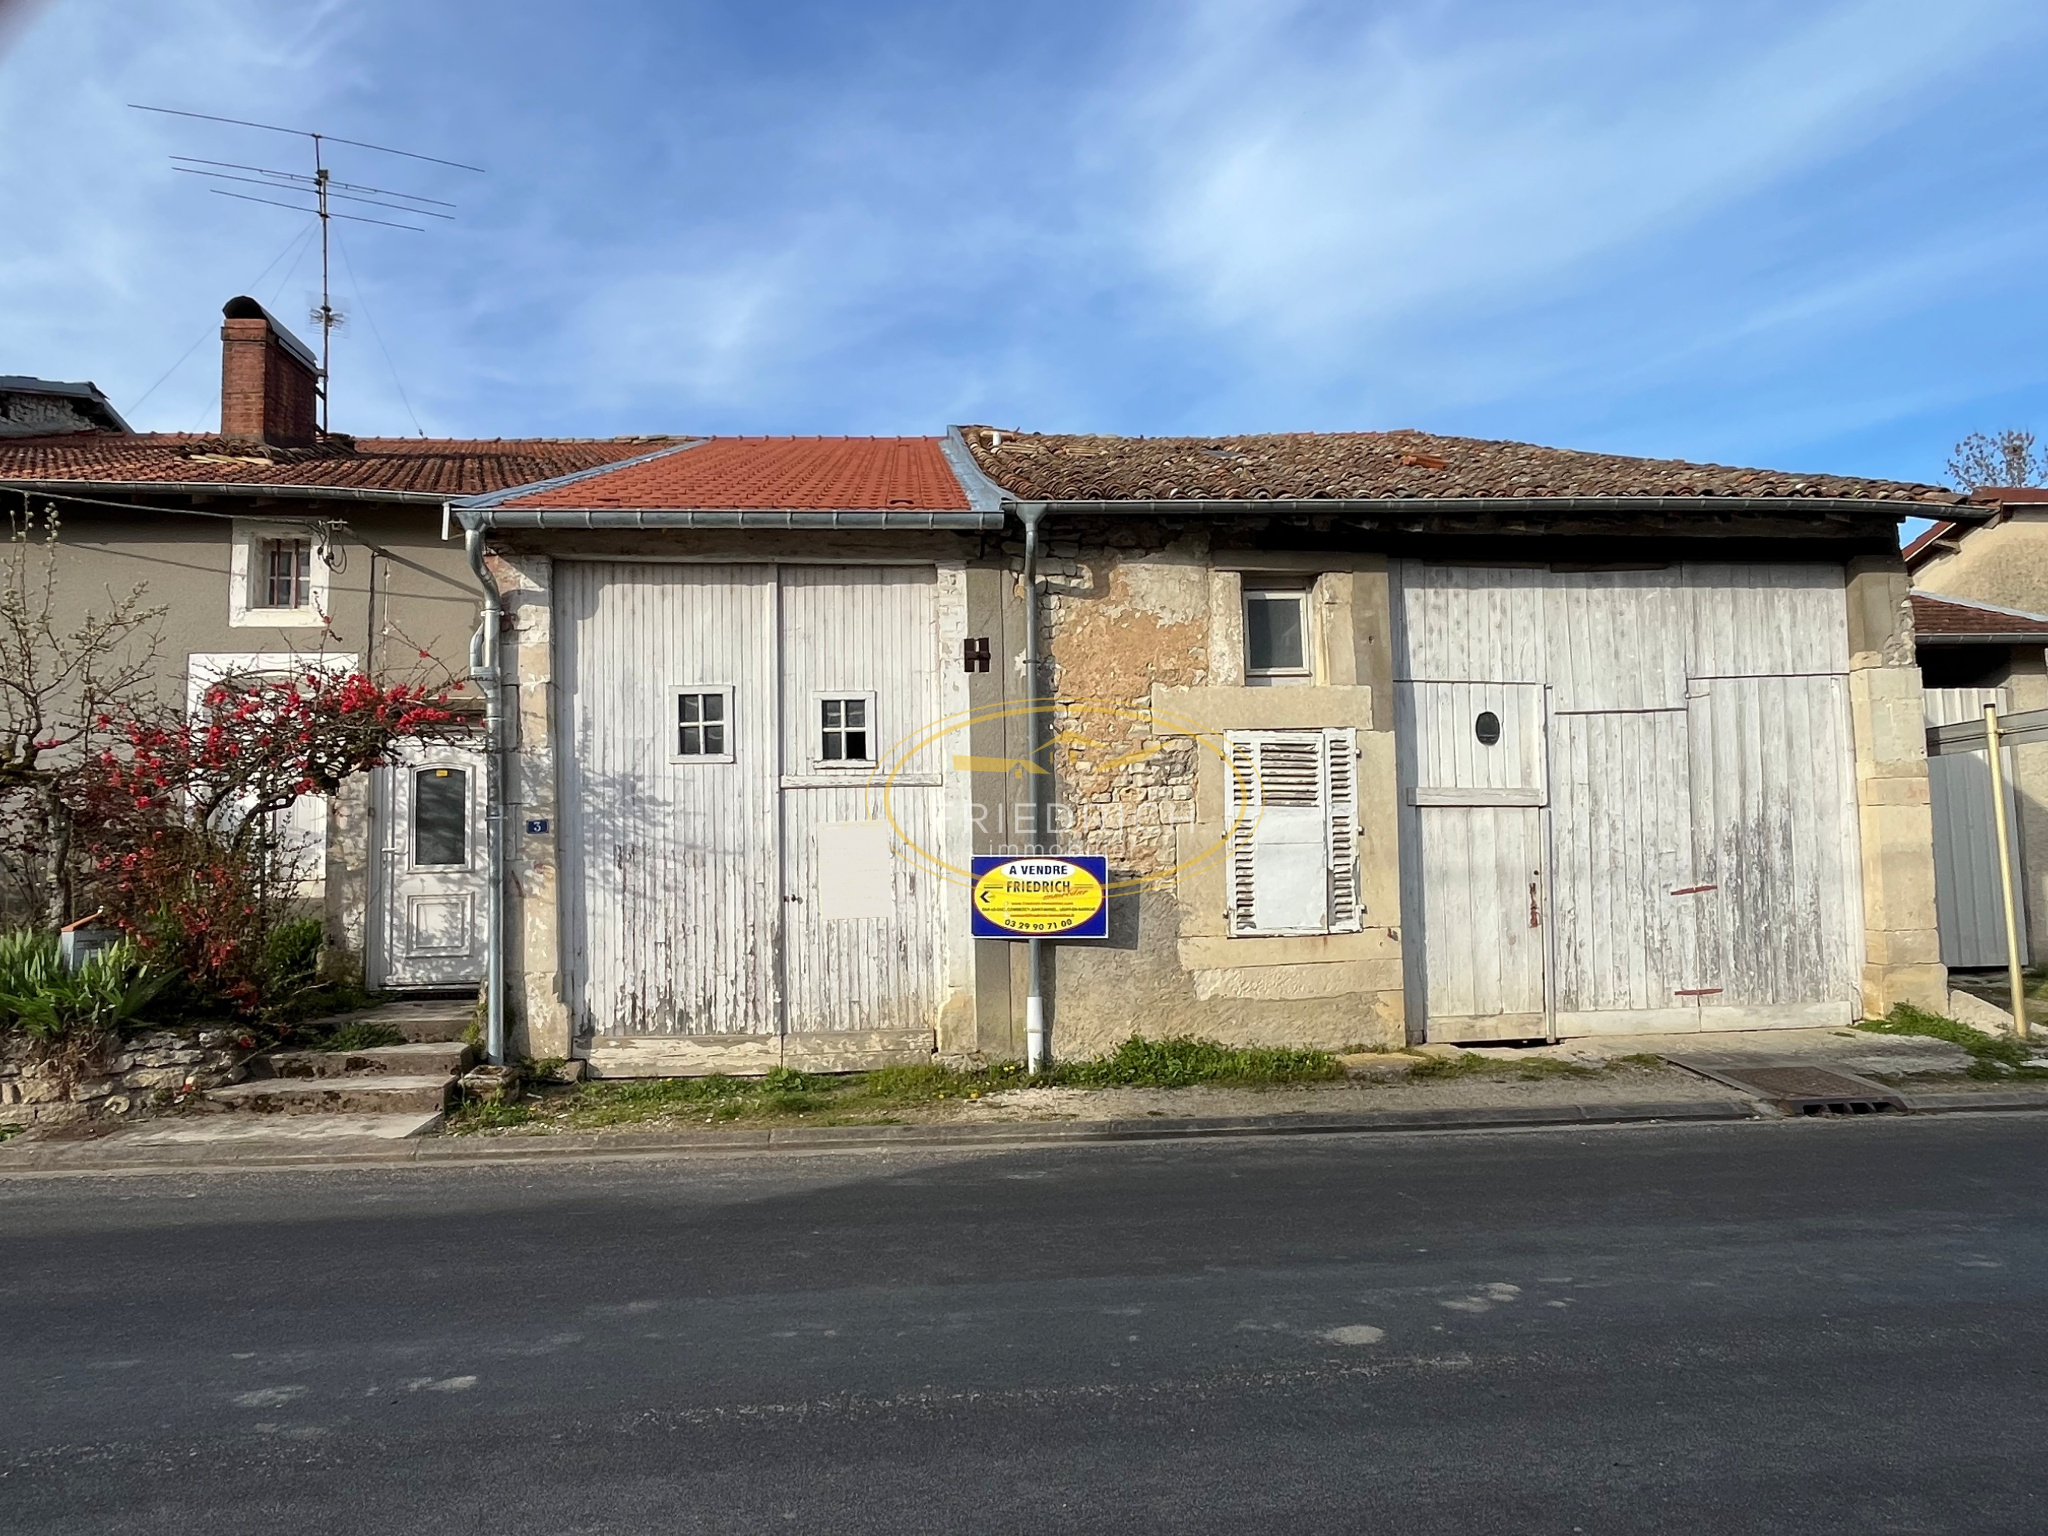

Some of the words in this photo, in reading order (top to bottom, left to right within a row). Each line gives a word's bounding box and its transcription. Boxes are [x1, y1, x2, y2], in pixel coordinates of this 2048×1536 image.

[533, 821, 542, 832] 3
[1009, 865, 1017, 875] A
[1021, 865, 1068, 875] VENDRE
[1006, 880, 1070, 893] FRIEDRICH
[1004, 919, 1016, 928] 03
[1018, 922, 1030, 930] 29
[1033, 923, 1044, 931] 90
[1047, 922, 1058, 930] 71
[1061, 918, 1072, 927] 00
